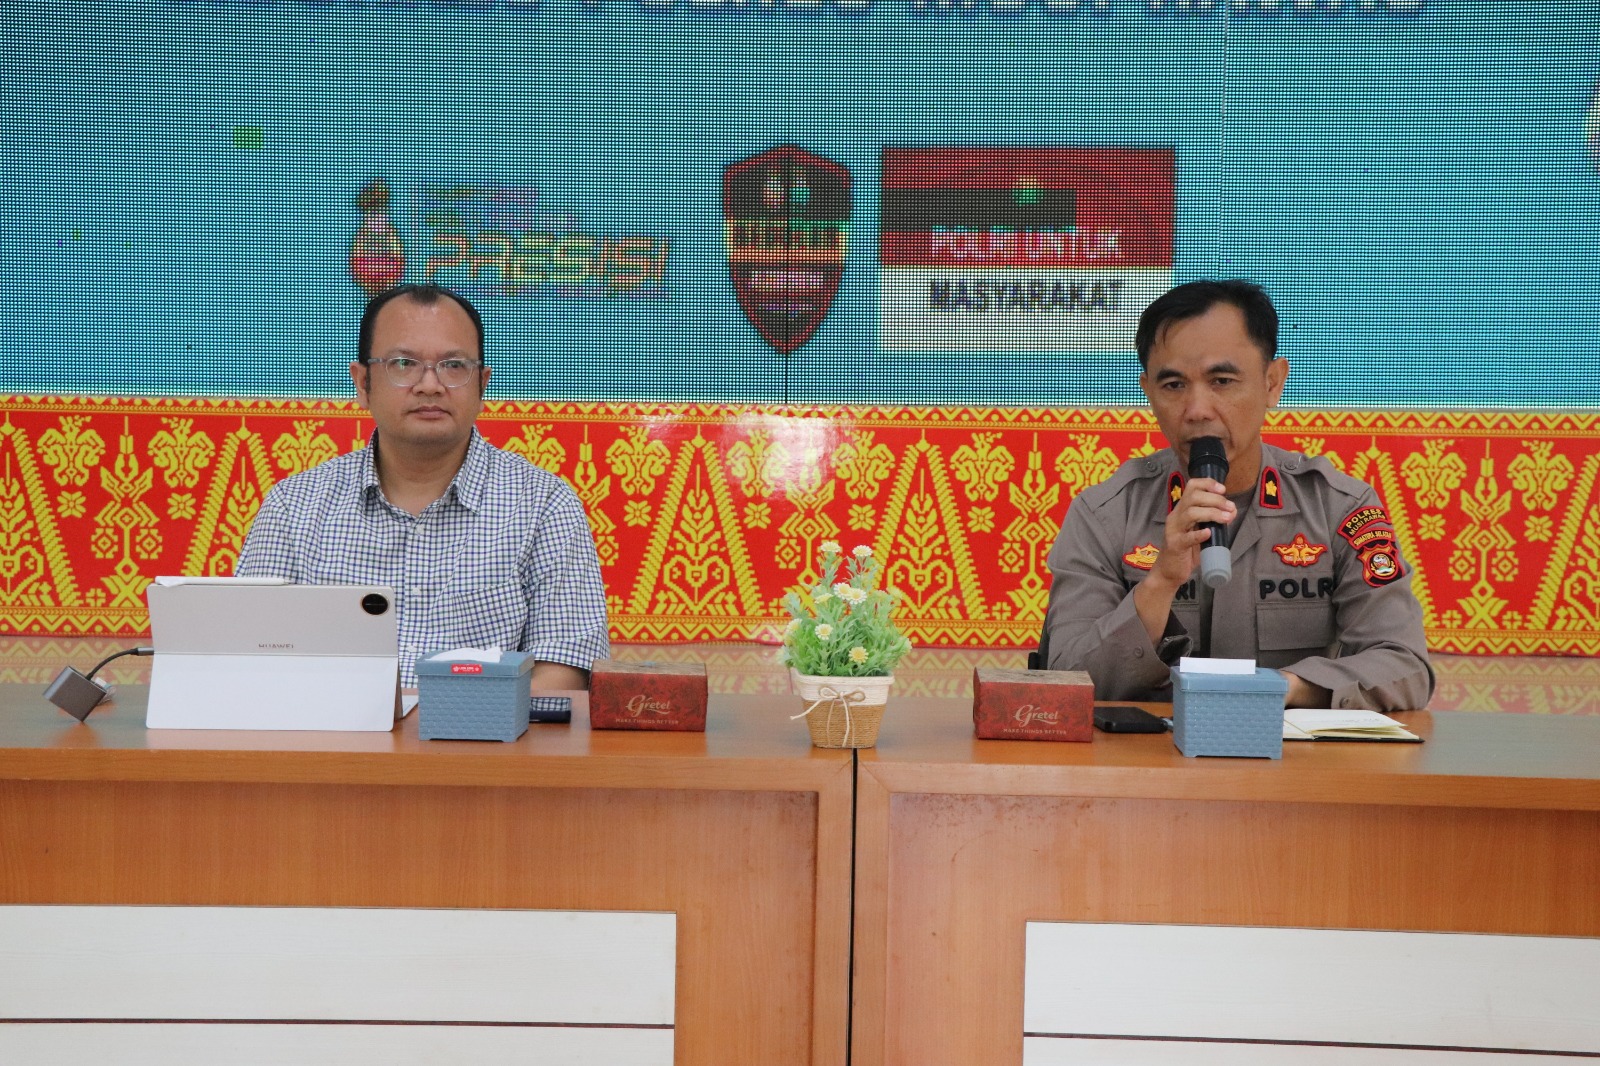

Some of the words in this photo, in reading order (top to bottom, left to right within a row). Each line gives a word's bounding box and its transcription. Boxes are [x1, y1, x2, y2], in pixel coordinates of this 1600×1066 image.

[930, 225, 1018, 260] POLRI
[1024, 225, 1125, 260] UNTUK
[425, 232, 670, 285] PRESISI
[929, 279, 1125, 312] MASYARAKAT
[1345, 508, 1382, 529] POLRES
[1348, 519, 1365, 536] MUSI
[1259, 577, 1335, 600] POLR
[625, 694, 672, 718] Gretel
[1012, 704, 1059, 728] Gretel
